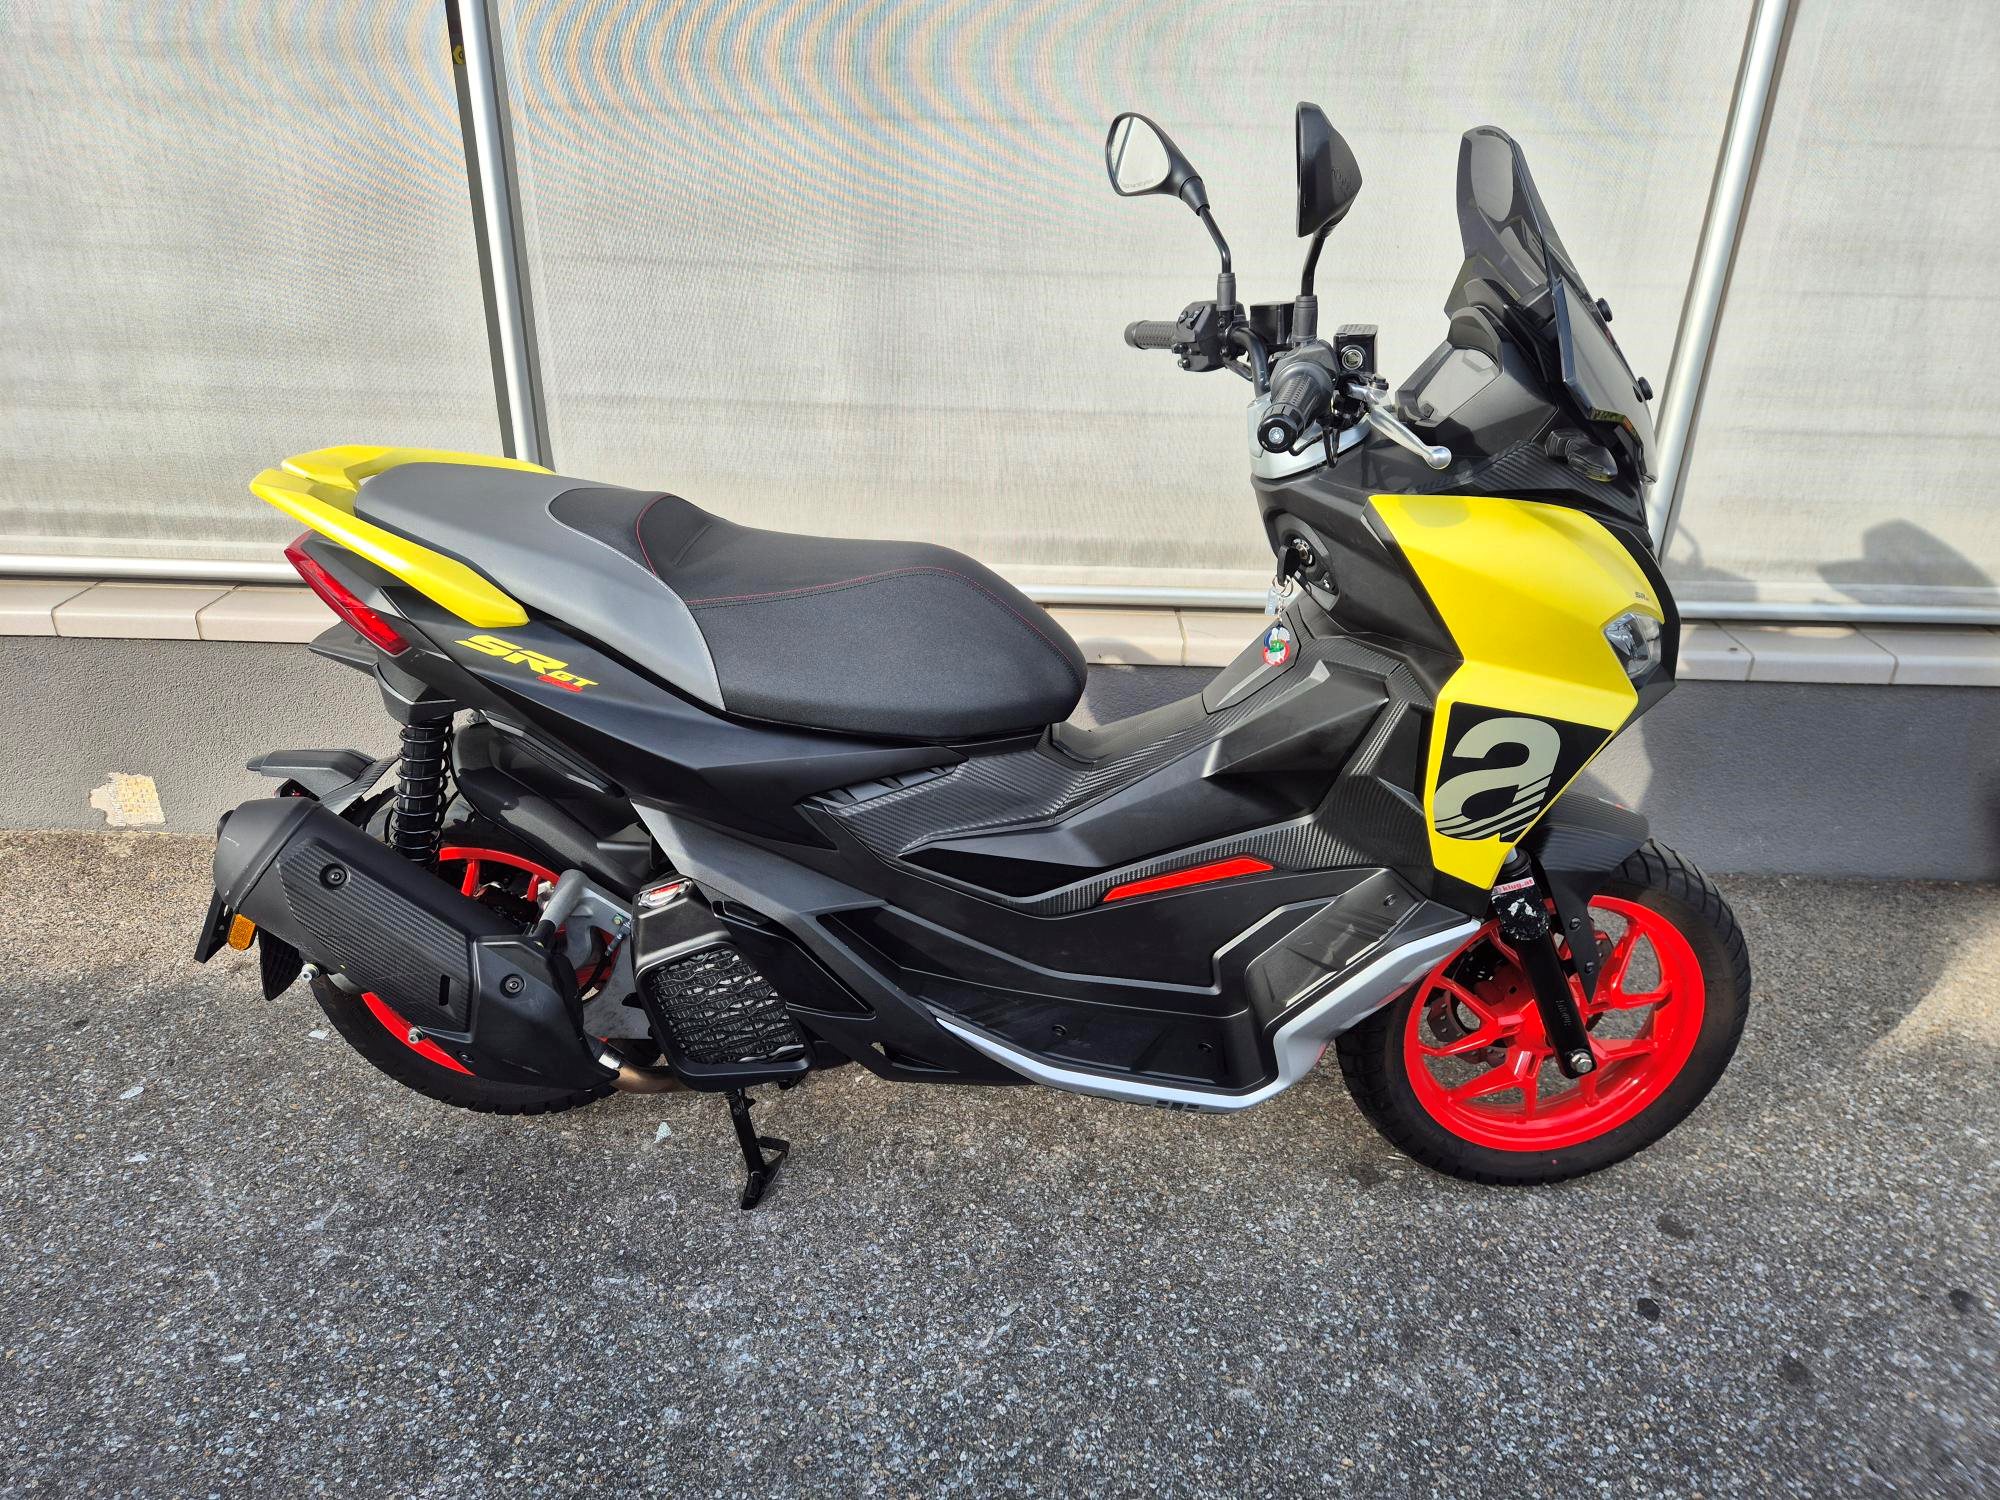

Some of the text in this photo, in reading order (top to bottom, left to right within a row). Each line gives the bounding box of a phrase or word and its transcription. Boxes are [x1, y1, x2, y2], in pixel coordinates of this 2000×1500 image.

[454, 635, 569, 675] SR
[547, 670, 600, 687] GT
[1433, 717, 1561, 841] 2
[1502, 879, 1534, 892] klug.at
